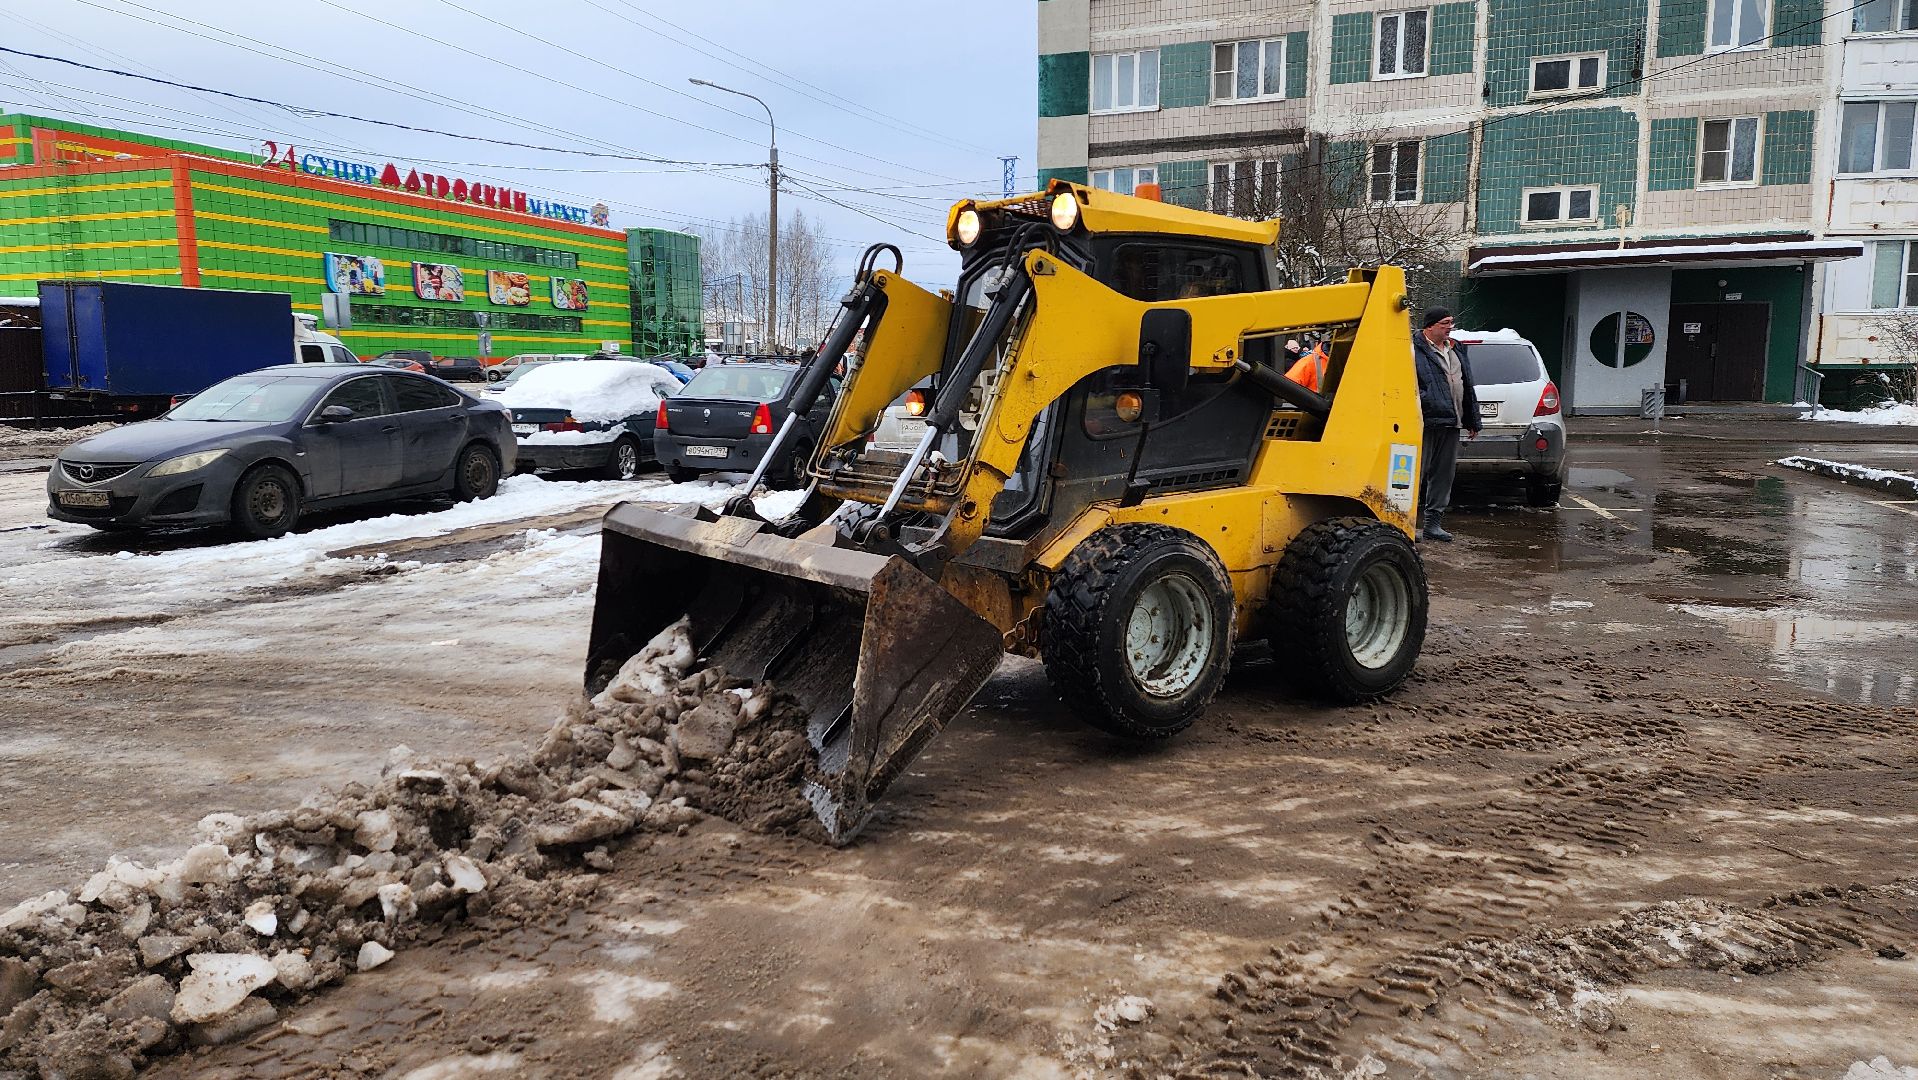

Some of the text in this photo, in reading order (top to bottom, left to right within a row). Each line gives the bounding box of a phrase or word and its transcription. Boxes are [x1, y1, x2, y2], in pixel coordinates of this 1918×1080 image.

[261, 140, 589, 224] 24 СУПЕР МАТРОСКИН МАРКЕТ
